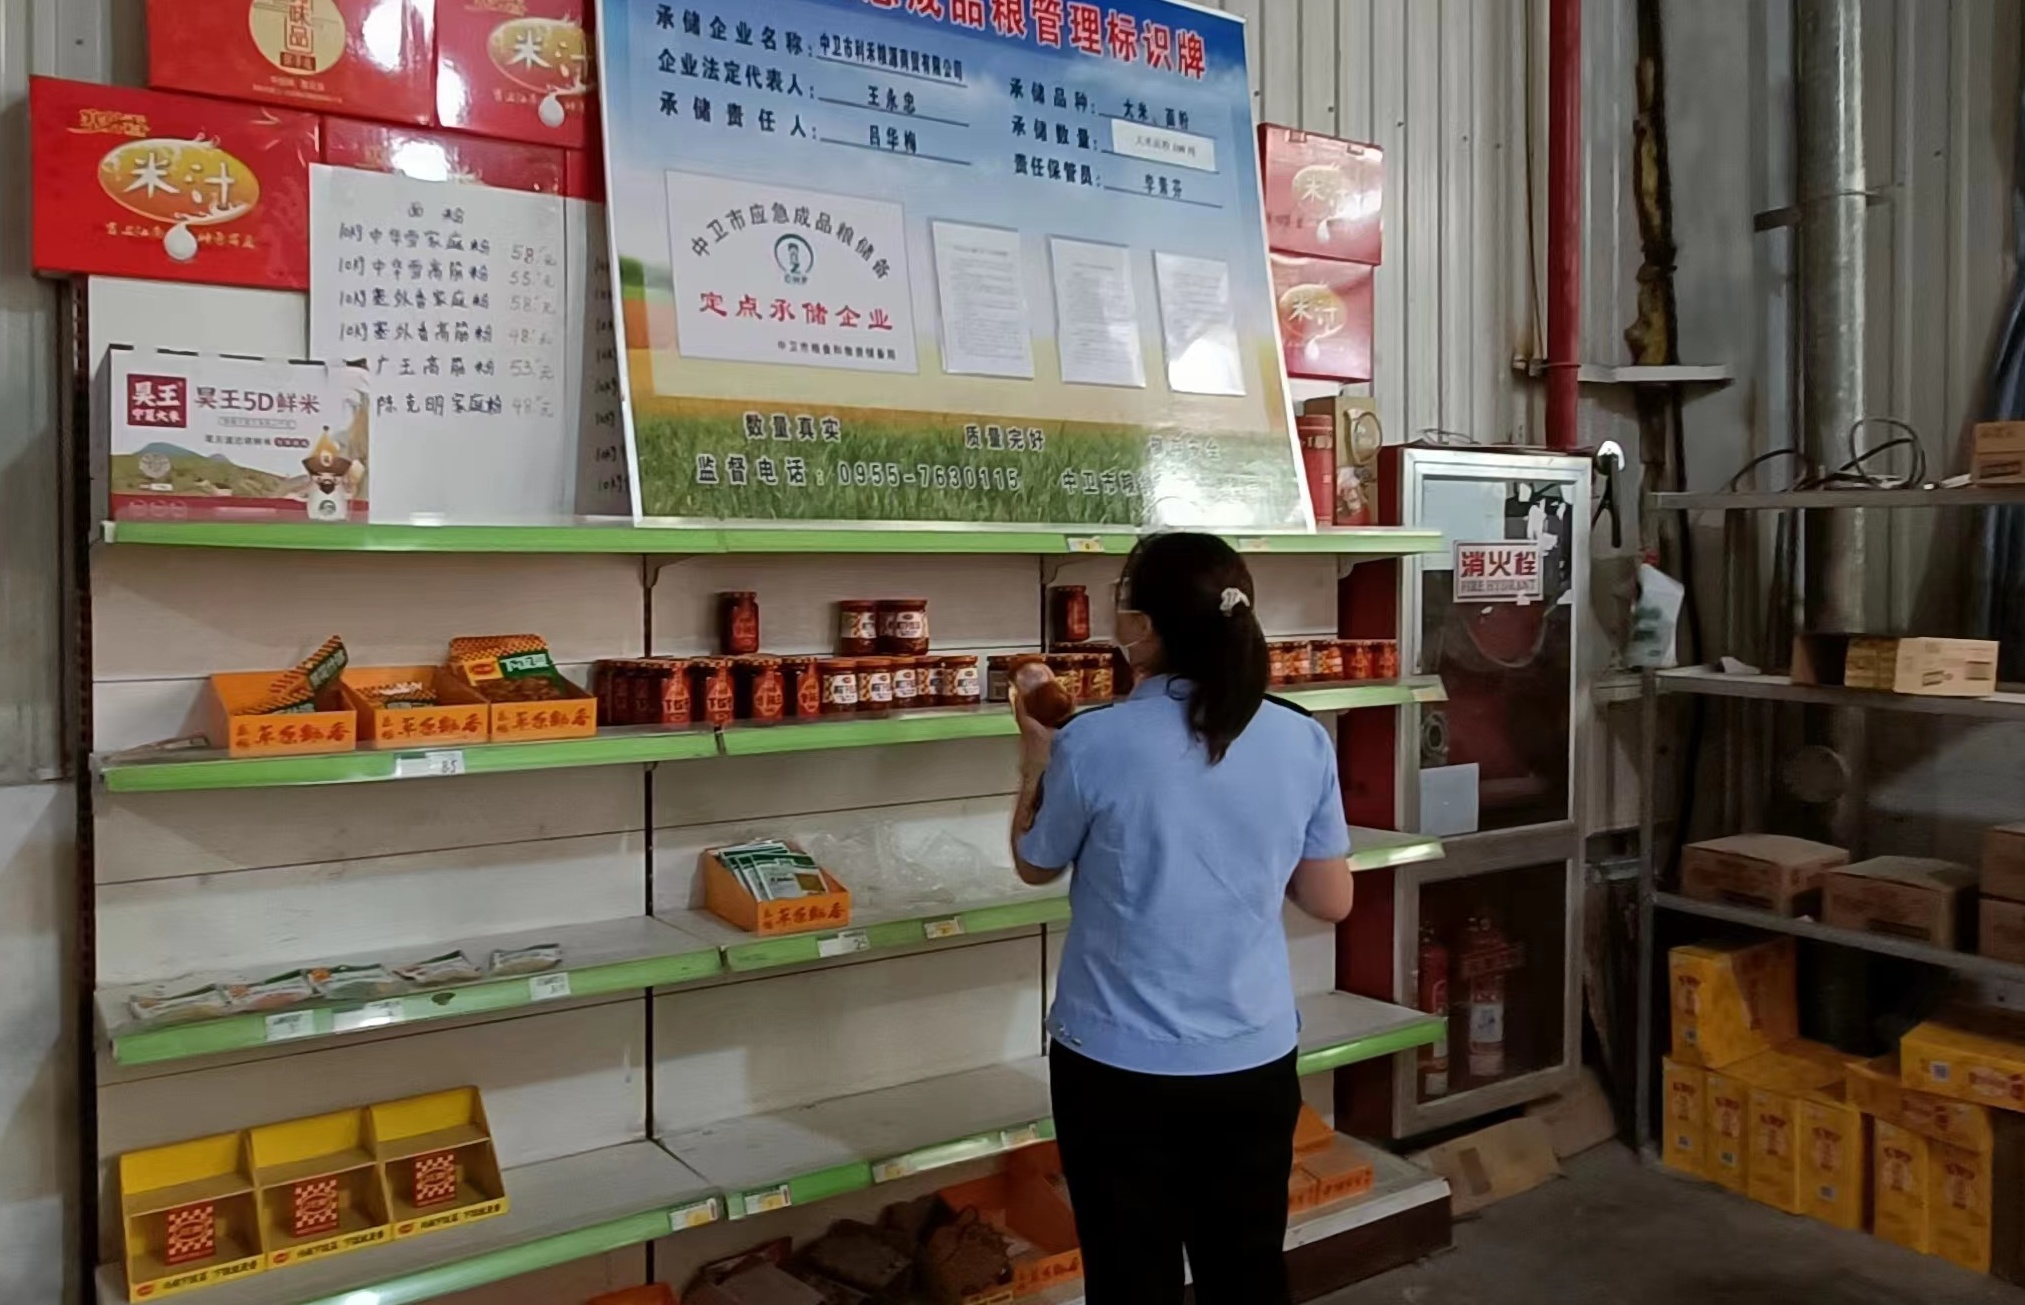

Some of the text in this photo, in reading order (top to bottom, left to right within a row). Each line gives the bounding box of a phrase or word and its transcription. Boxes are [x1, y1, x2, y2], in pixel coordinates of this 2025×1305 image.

[657, 48, 815, 99] 企业法定代表人：
[659, 91, 818, 140] 承储责任人：
[122, 152, 236, 209] 米汁
[700, 292, 893, 330] 定点承储企业
[743, 411, 841, 442] 数量真实
[964, 424, 1045, 452] 质量完好
[1461, 551, 1538, 577] 消火栓
